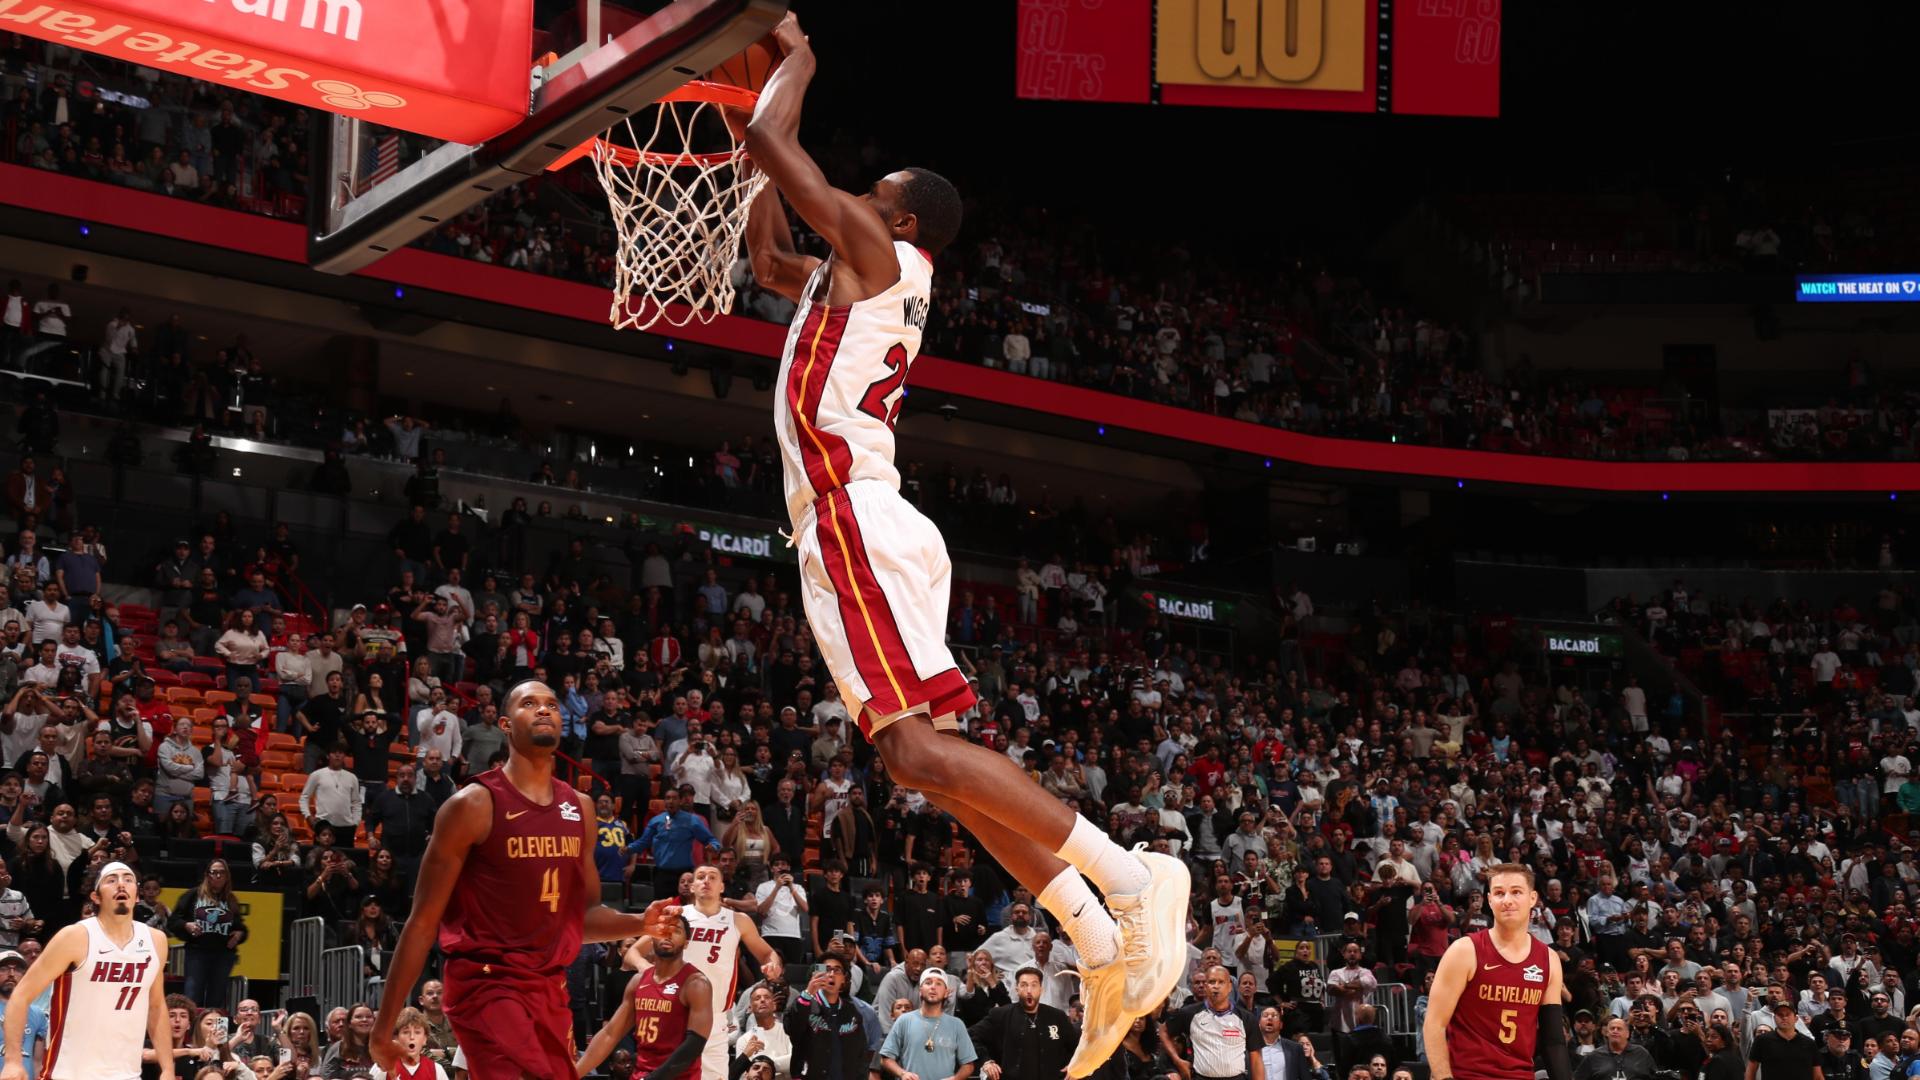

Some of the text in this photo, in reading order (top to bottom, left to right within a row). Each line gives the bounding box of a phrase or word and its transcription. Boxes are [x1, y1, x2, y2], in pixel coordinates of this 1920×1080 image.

[1195, 0, 1324, 83] GO
[1801, 282, 1900, 295] WATCH THE HEAT ON
[1158, 598, 1215, 621] BACARDÍ
[1549, 637, 1600, 653] BACARDÍ
[507, 836, 581, 858] CLEVELAND
[598, 827, 625, 847] 30
[540, 867, 560, 912] 4
[707, 945, 721, 964] 5
[90, 959, 150, 983] HEAT
[115, 986, 142, 1010] 11
[635, 997, 672, 1013] CLEVELAND
[1479, 984, 1542, 1005] CLEVELAND
[637, 1016, 660, 1043] 45
[1498, 1009, 1518, 1044] 5
